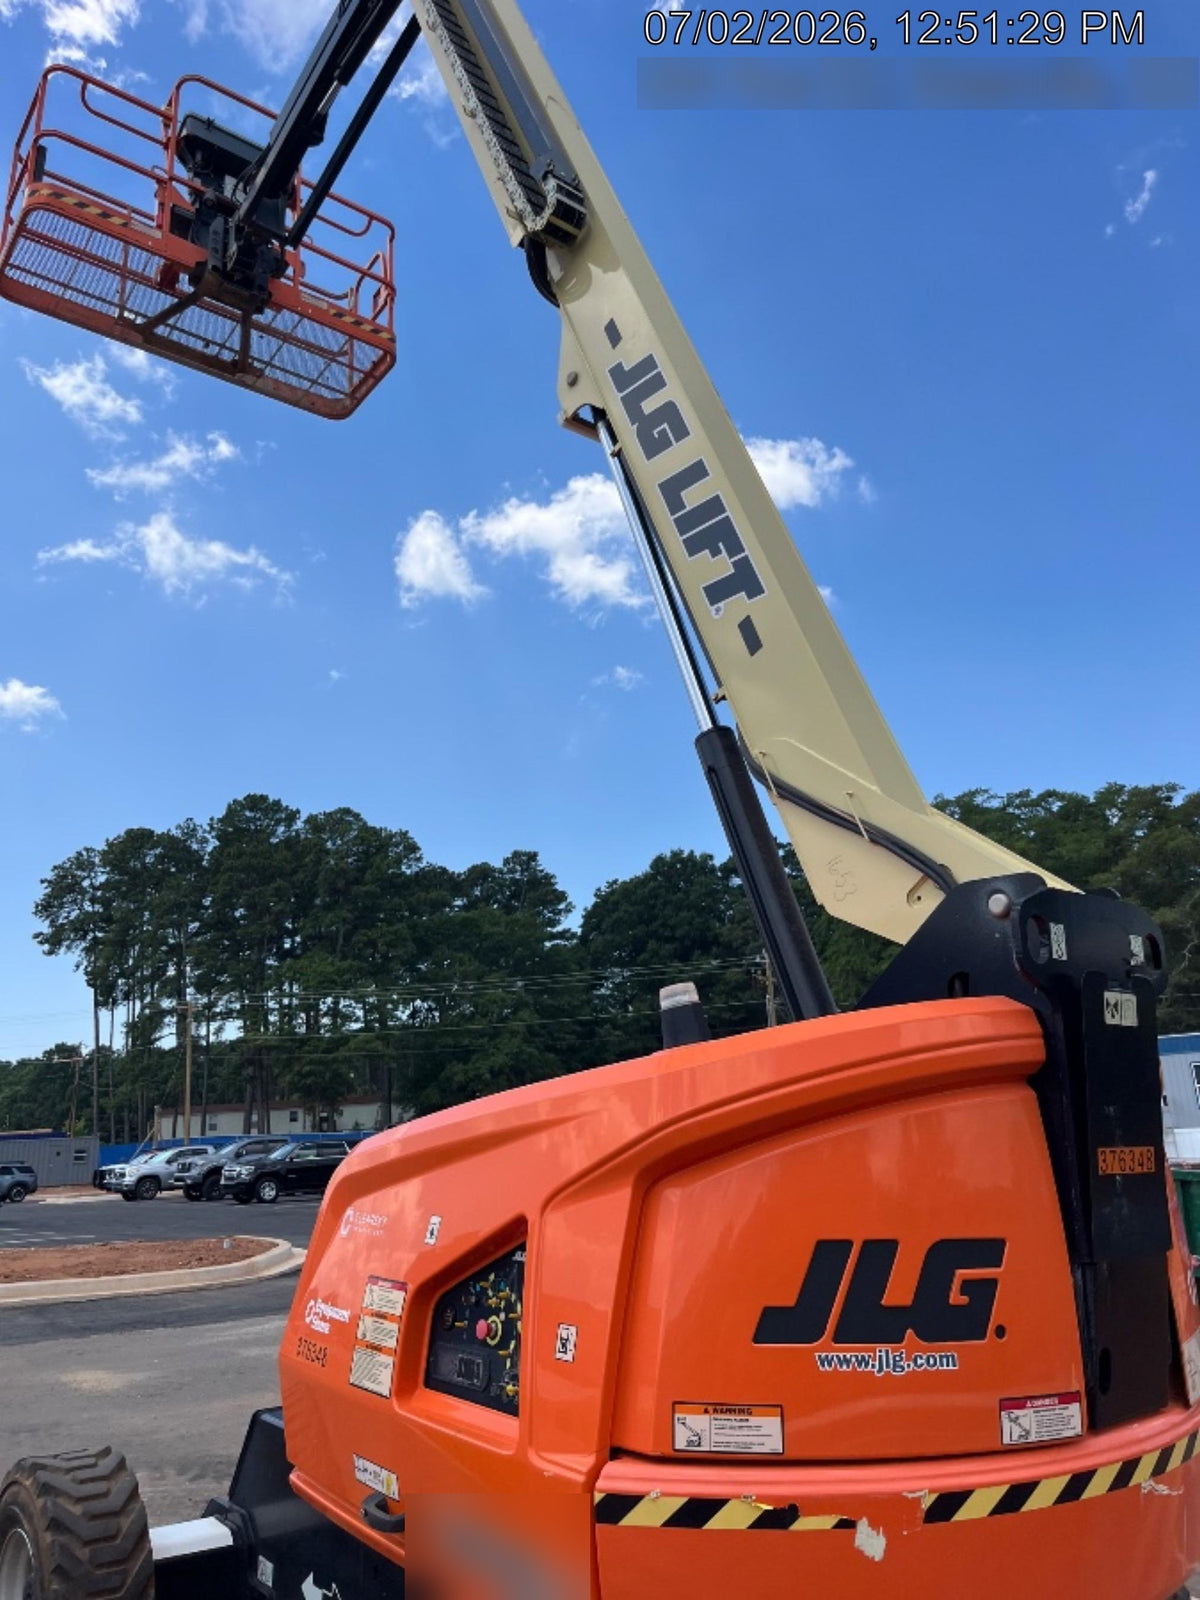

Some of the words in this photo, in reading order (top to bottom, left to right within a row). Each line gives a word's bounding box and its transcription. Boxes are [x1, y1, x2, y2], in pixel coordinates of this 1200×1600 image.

[608, 353, 690, 462] JLG
[657, 458, 766, 607] LIFT
[1100, 1149, 1153, 1173] 376348
[753, 1238, 1006, 1344] JLG
[816, 1349, 958, 1375] www.jlg.com
